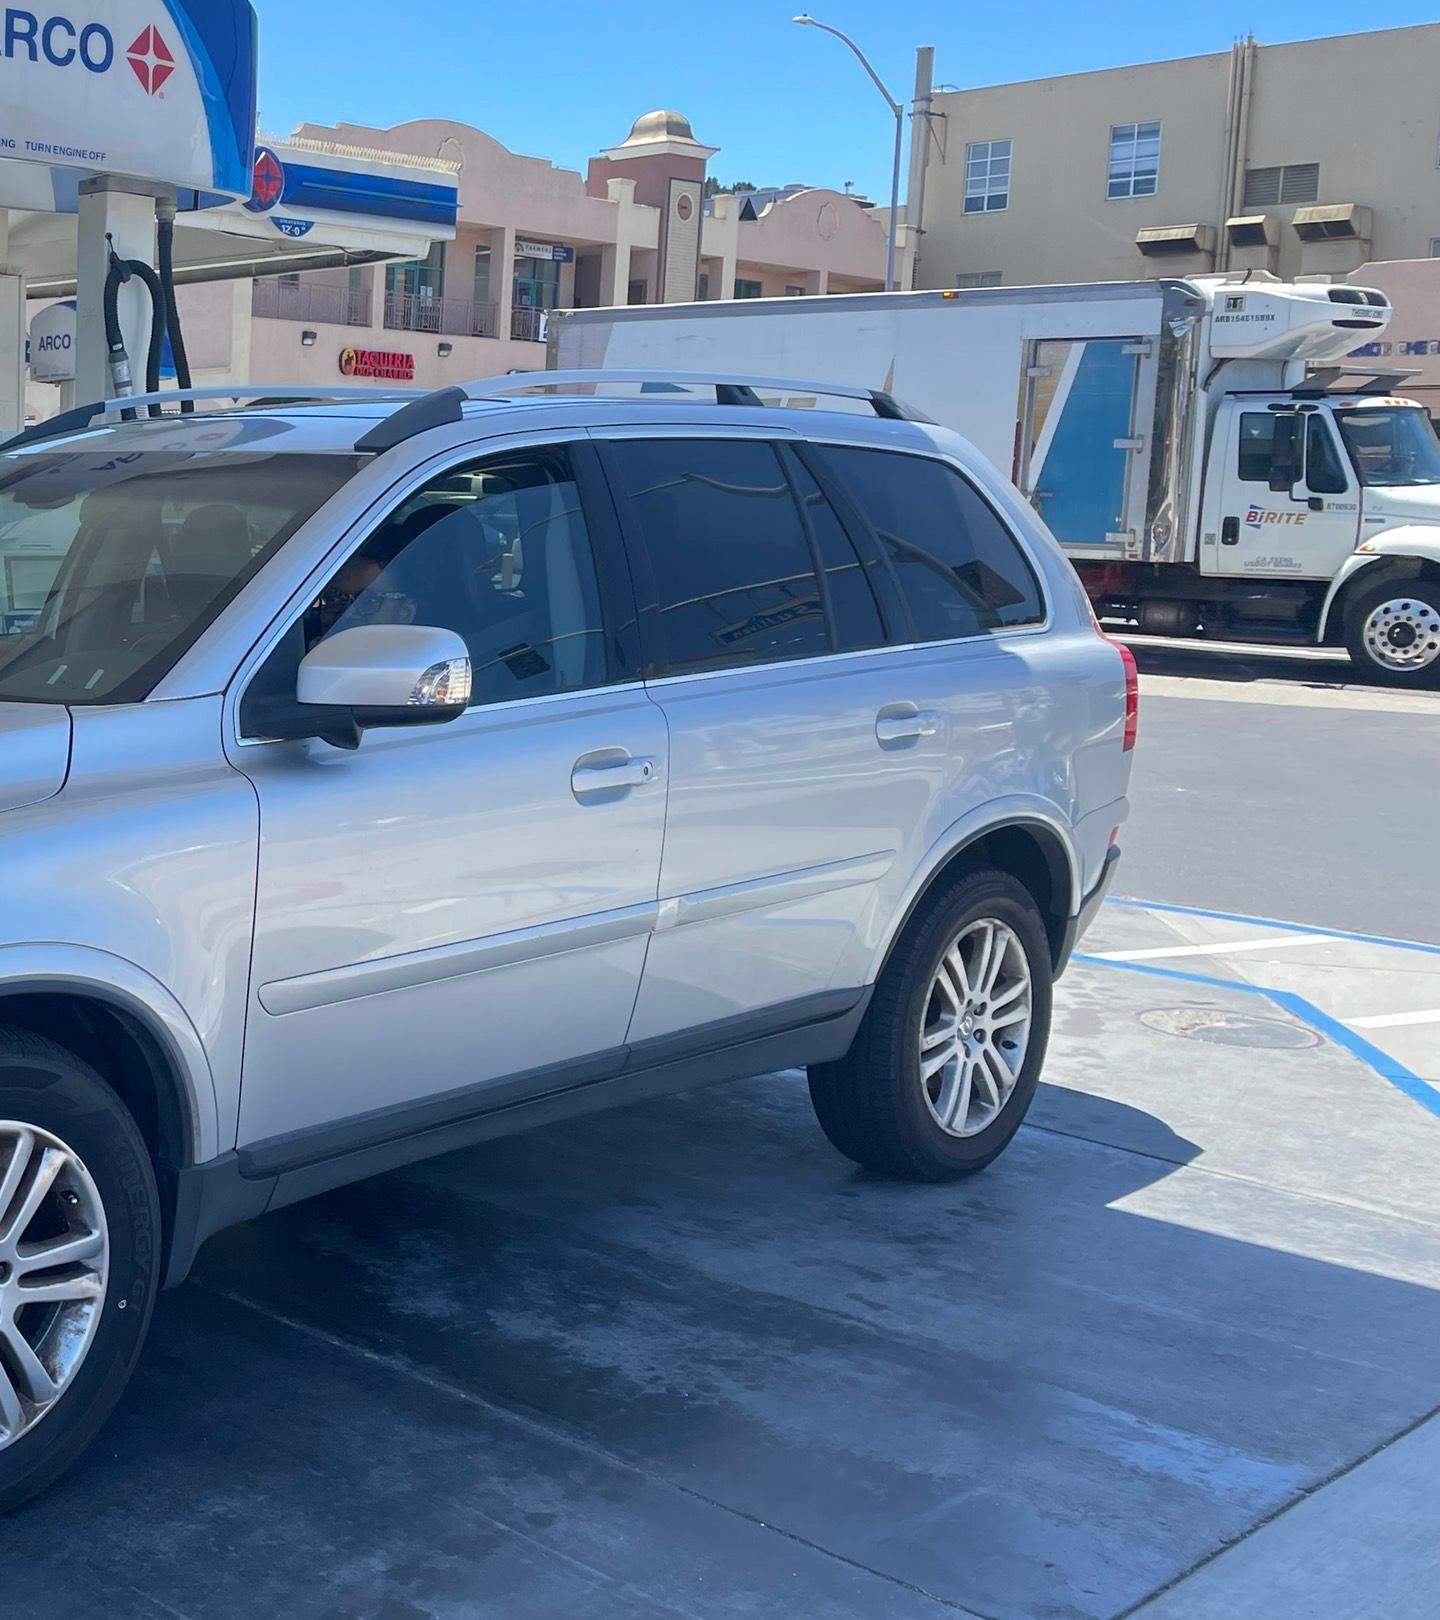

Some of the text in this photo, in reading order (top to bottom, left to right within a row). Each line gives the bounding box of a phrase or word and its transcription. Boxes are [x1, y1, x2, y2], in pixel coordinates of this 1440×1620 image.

[25, 140, 107, 162] TURN ENGINE OFF
[38, 334, 71, 352] ARCO
[355, 349, 416, 369] TAQUERIA
